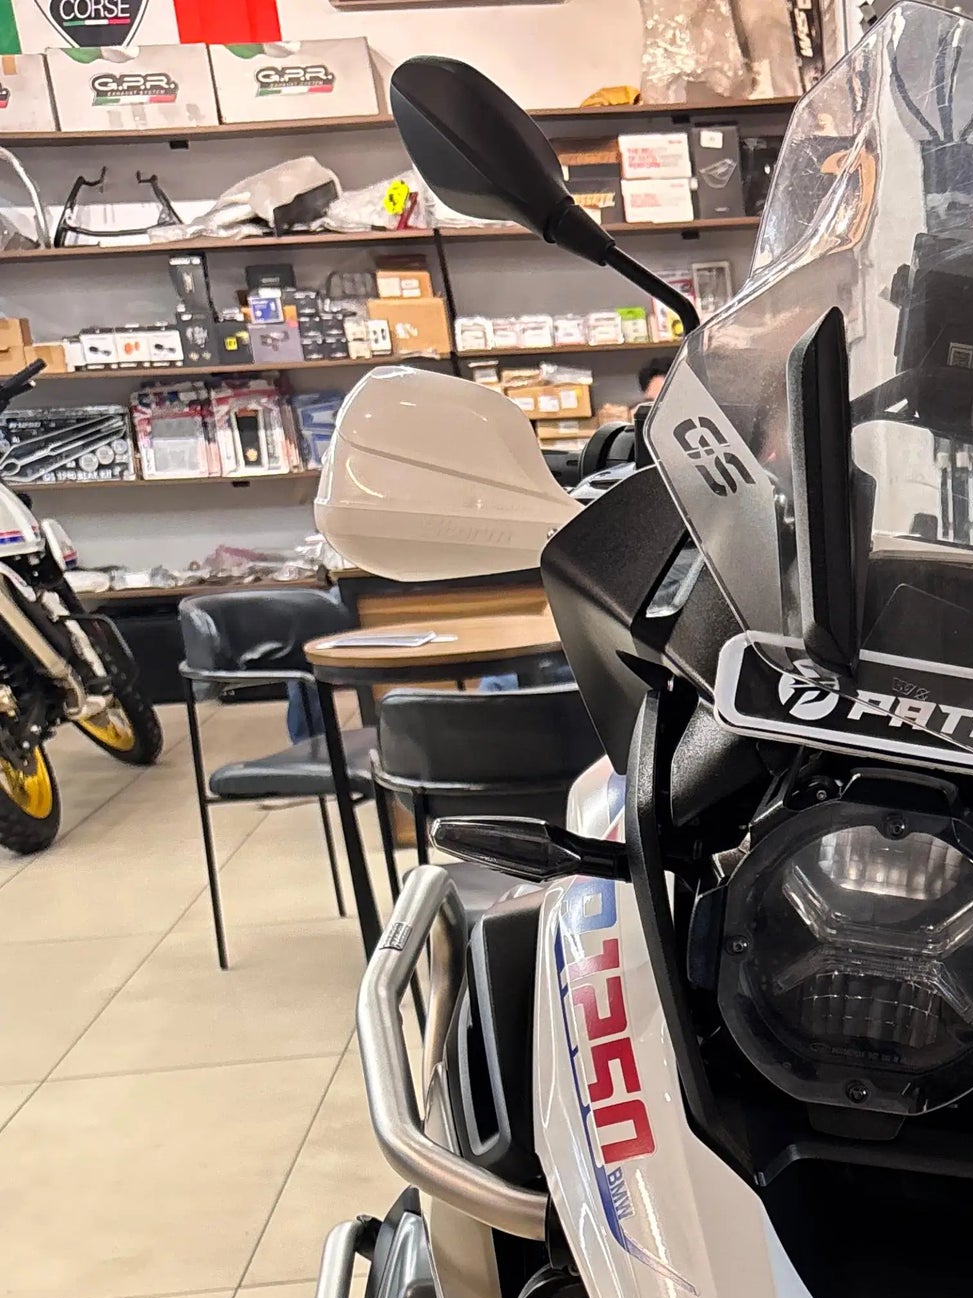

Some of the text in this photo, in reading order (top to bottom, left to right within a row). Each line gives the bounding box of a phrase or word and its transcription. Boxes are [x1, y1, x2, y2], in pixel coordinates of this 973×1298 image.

[60, 0, 130, 20] CORSE
[673, 416, 756, 497] GS
[567, 938, 655, 1165] 1250
[607, 1166, 634, 1221] BMW
